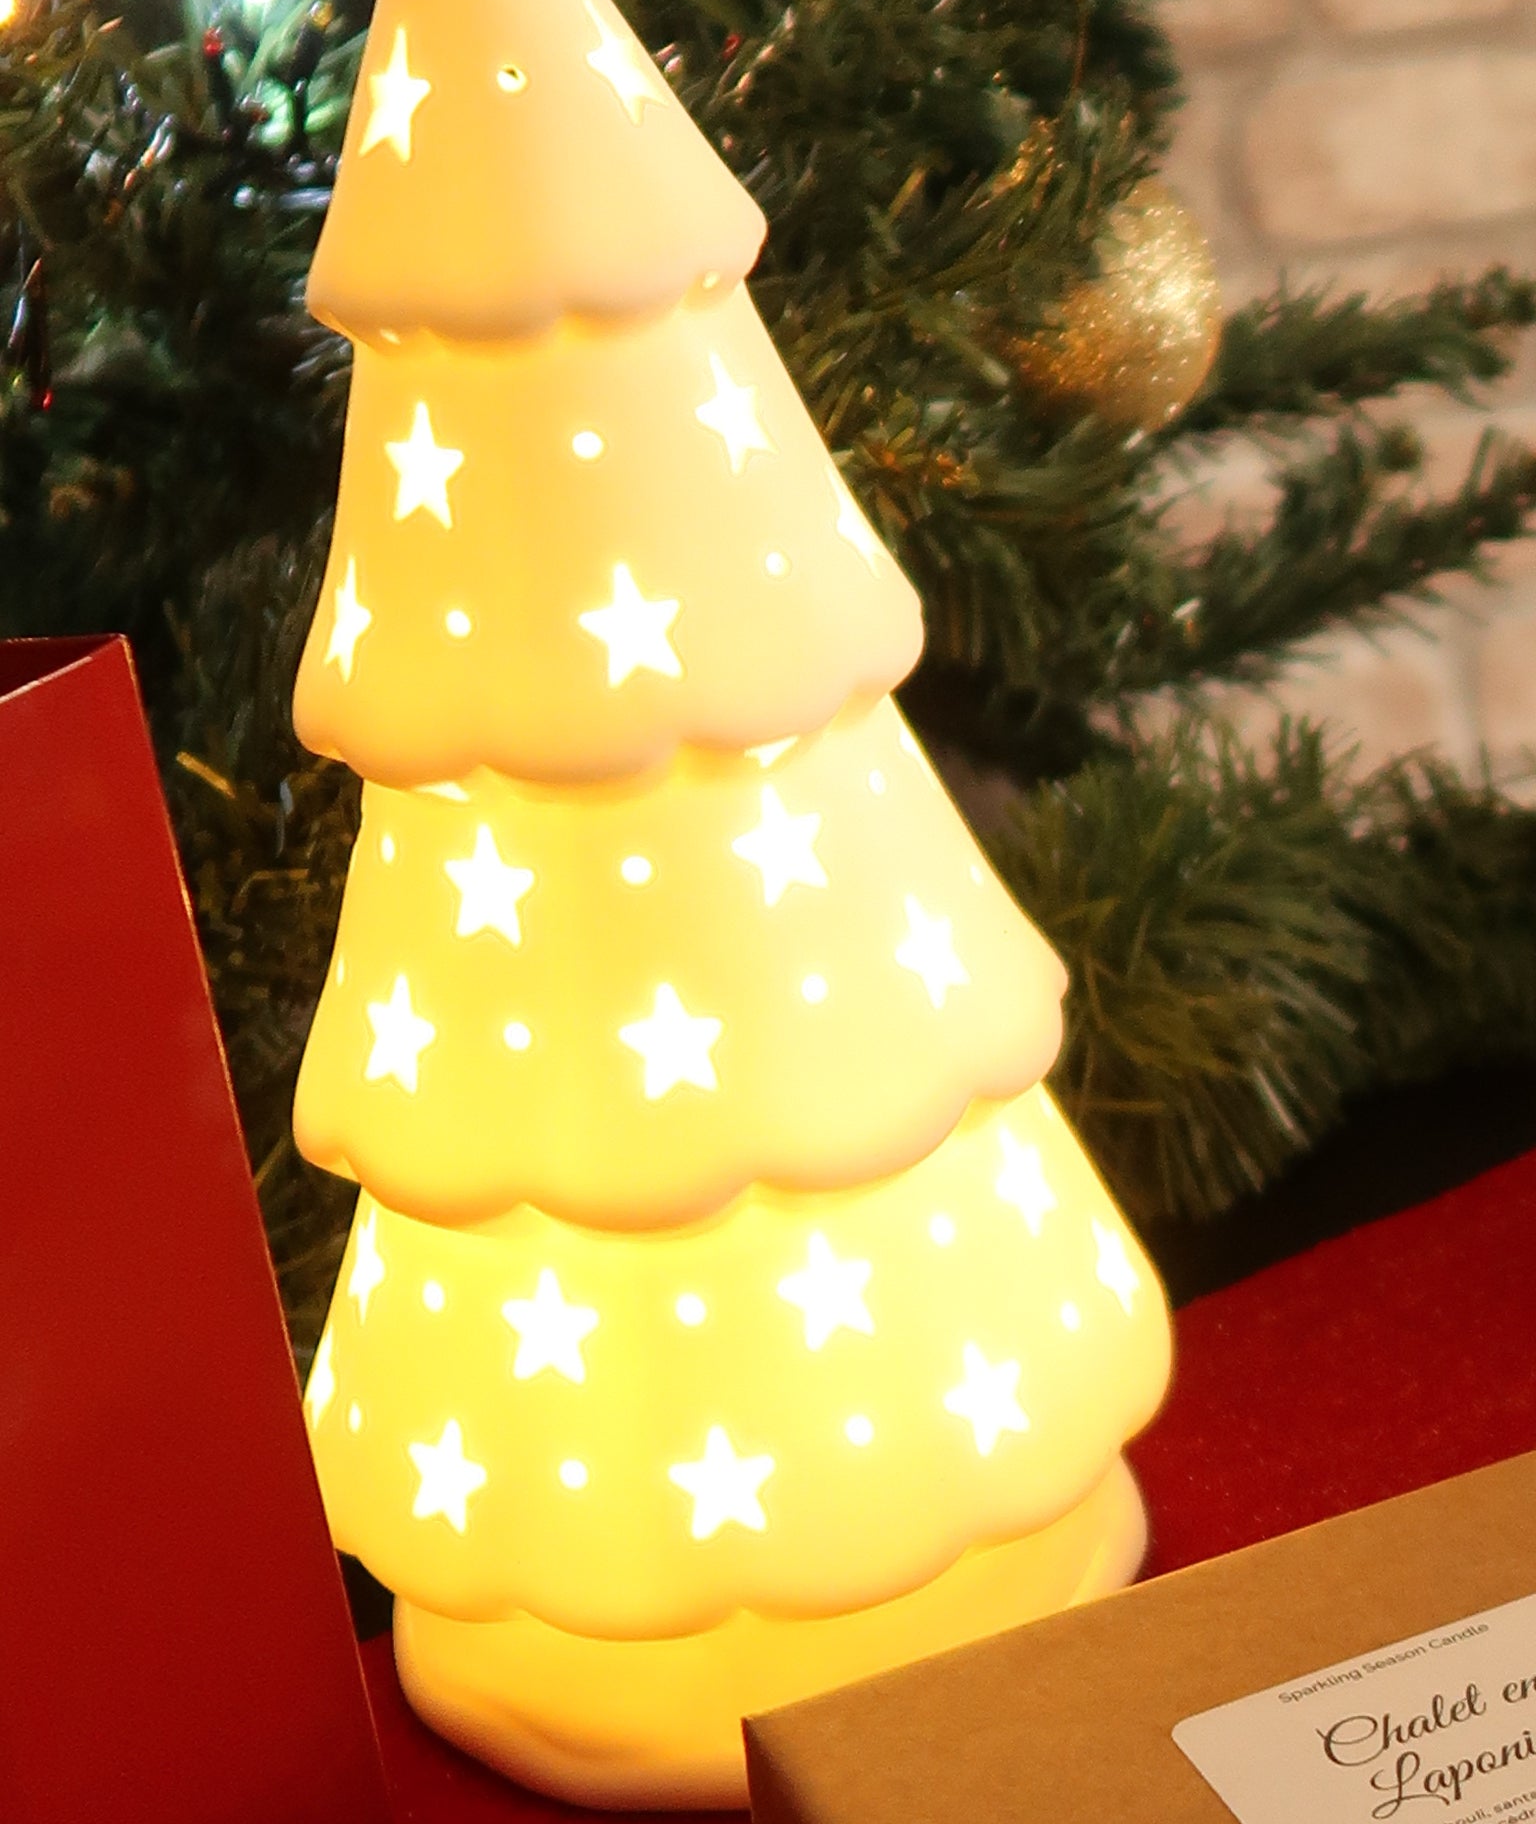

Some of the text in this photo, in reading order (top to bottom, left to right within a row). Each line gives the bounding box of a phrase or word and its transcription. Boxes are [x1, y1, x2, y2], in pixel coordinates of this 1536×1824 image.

[1277, 1622, 1490, 1704] Sparkling Season Candle
[1315, 1682, 1488, 1767] Chalet
